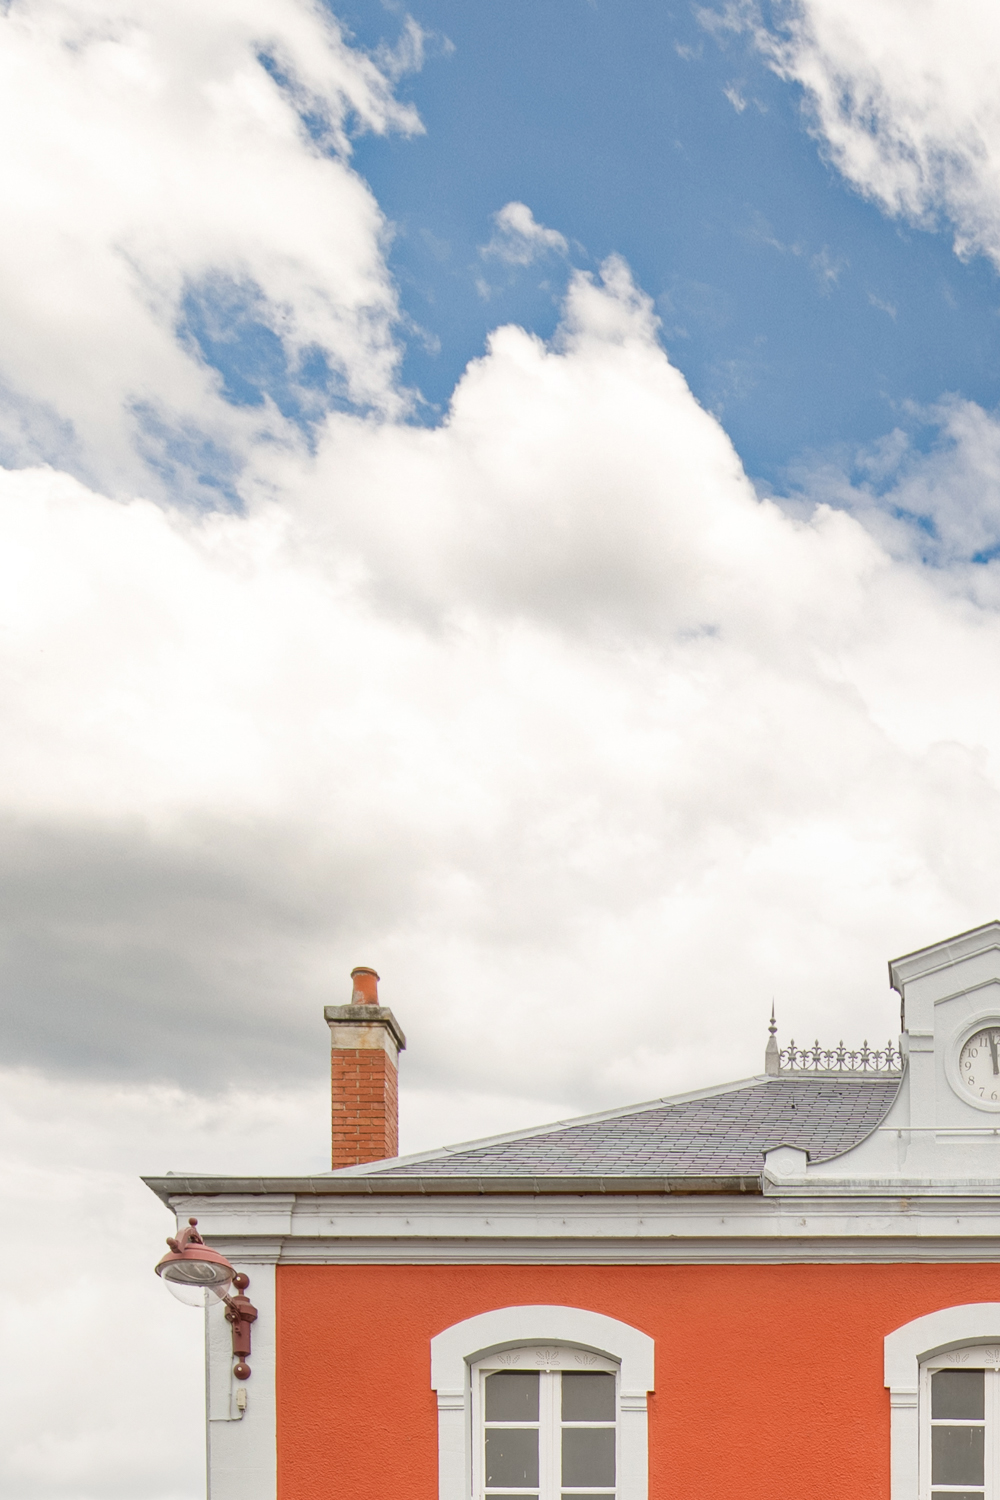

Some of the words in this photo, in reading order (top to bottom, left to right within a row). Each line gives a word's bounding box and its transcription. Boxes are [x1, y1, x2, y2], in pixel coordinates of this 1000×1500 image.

[979, 1037, 988, 1047] 11
[968, 1048, 978, 1058] 10
[964, 1061, 972, 1071] 9
[967, 1076, 975, 1085] 8
[979, 1087, 985, 1097] 7
[990, 1090, 997, 1100] 6
